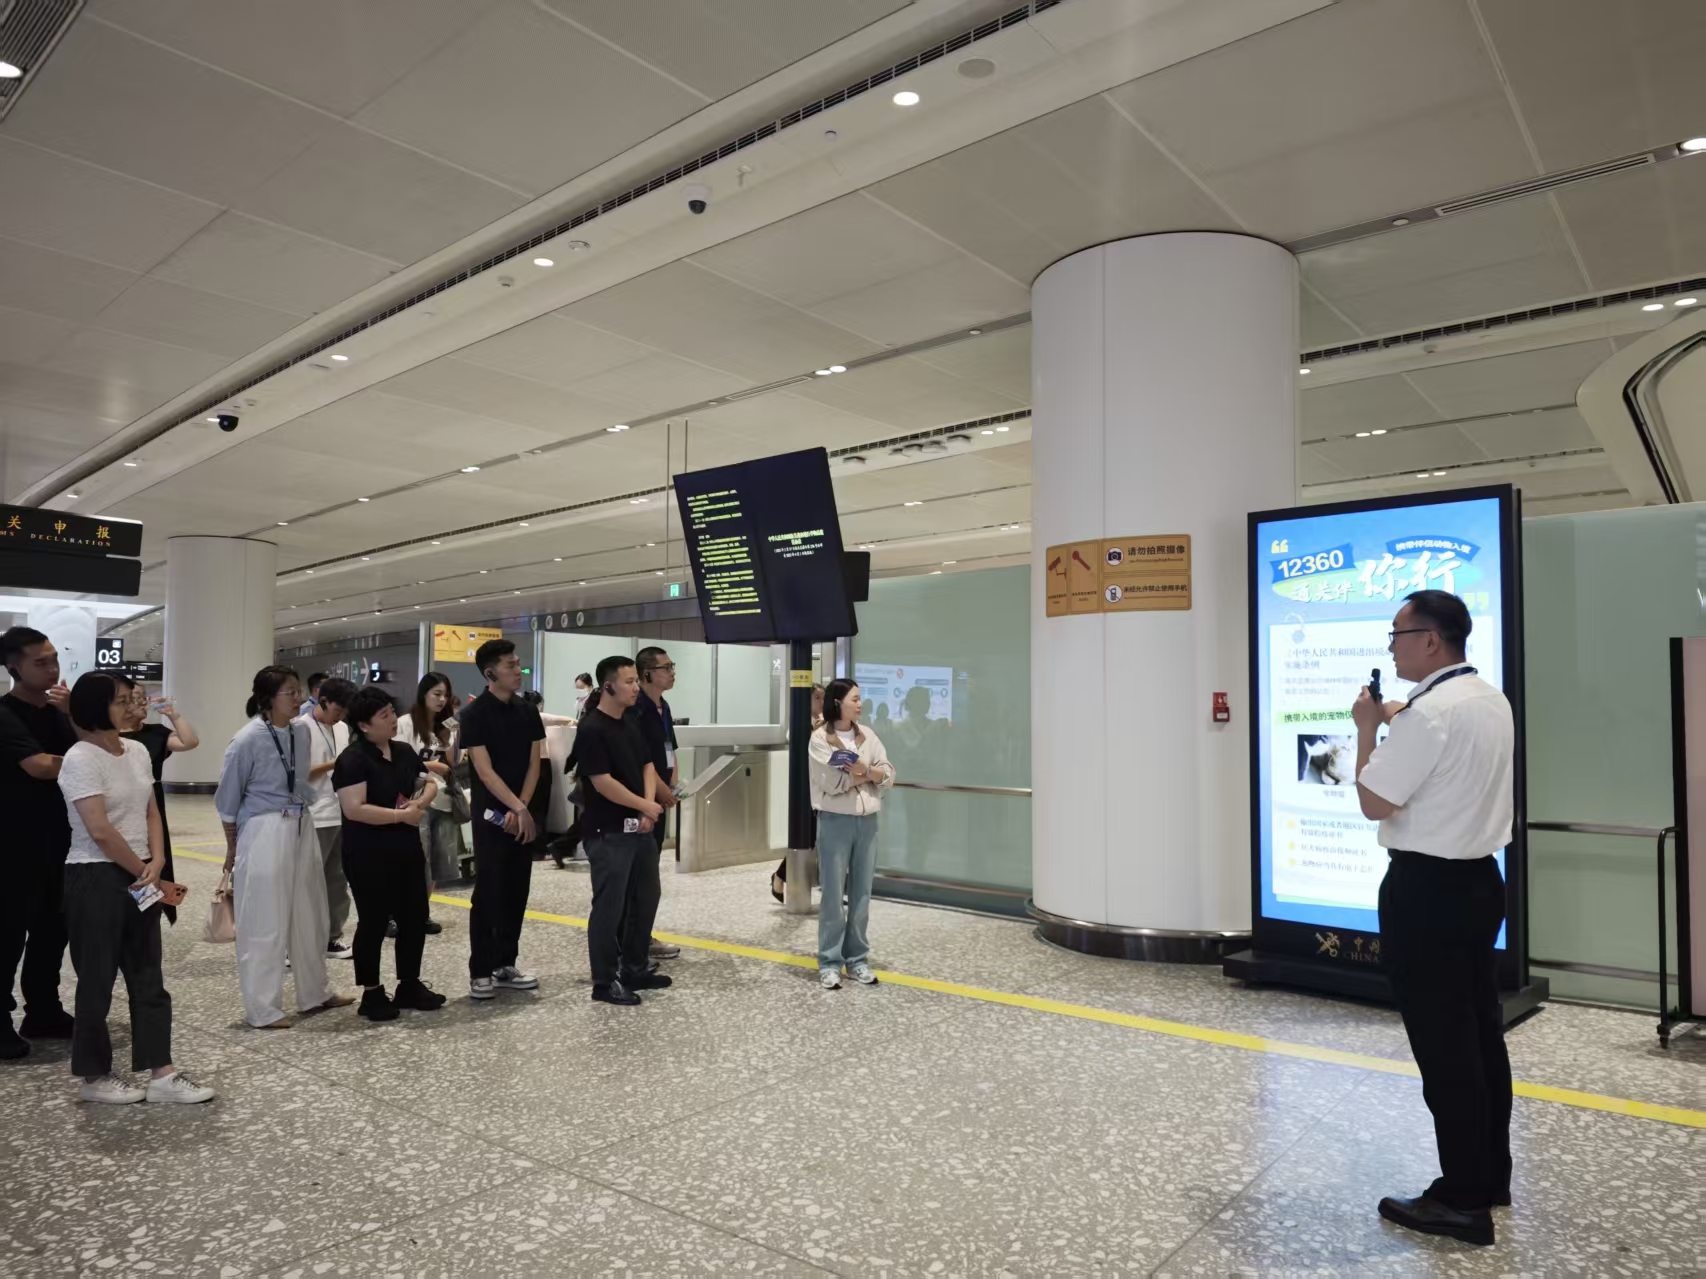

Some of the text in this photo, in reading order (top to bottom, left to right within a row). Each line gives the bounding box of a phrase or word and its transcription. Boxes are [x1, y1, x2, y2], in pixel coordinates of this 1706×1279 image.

[30, 533, 111, 547] DECLARATION
[1128, 545, 1185, 556] 请勿拍照摄像
[1277, 549, 1344, 578] 12360
[1124, 584, 1187, 593] 未经允许禁止使用手机
[98, 649, 120, 664] 03
